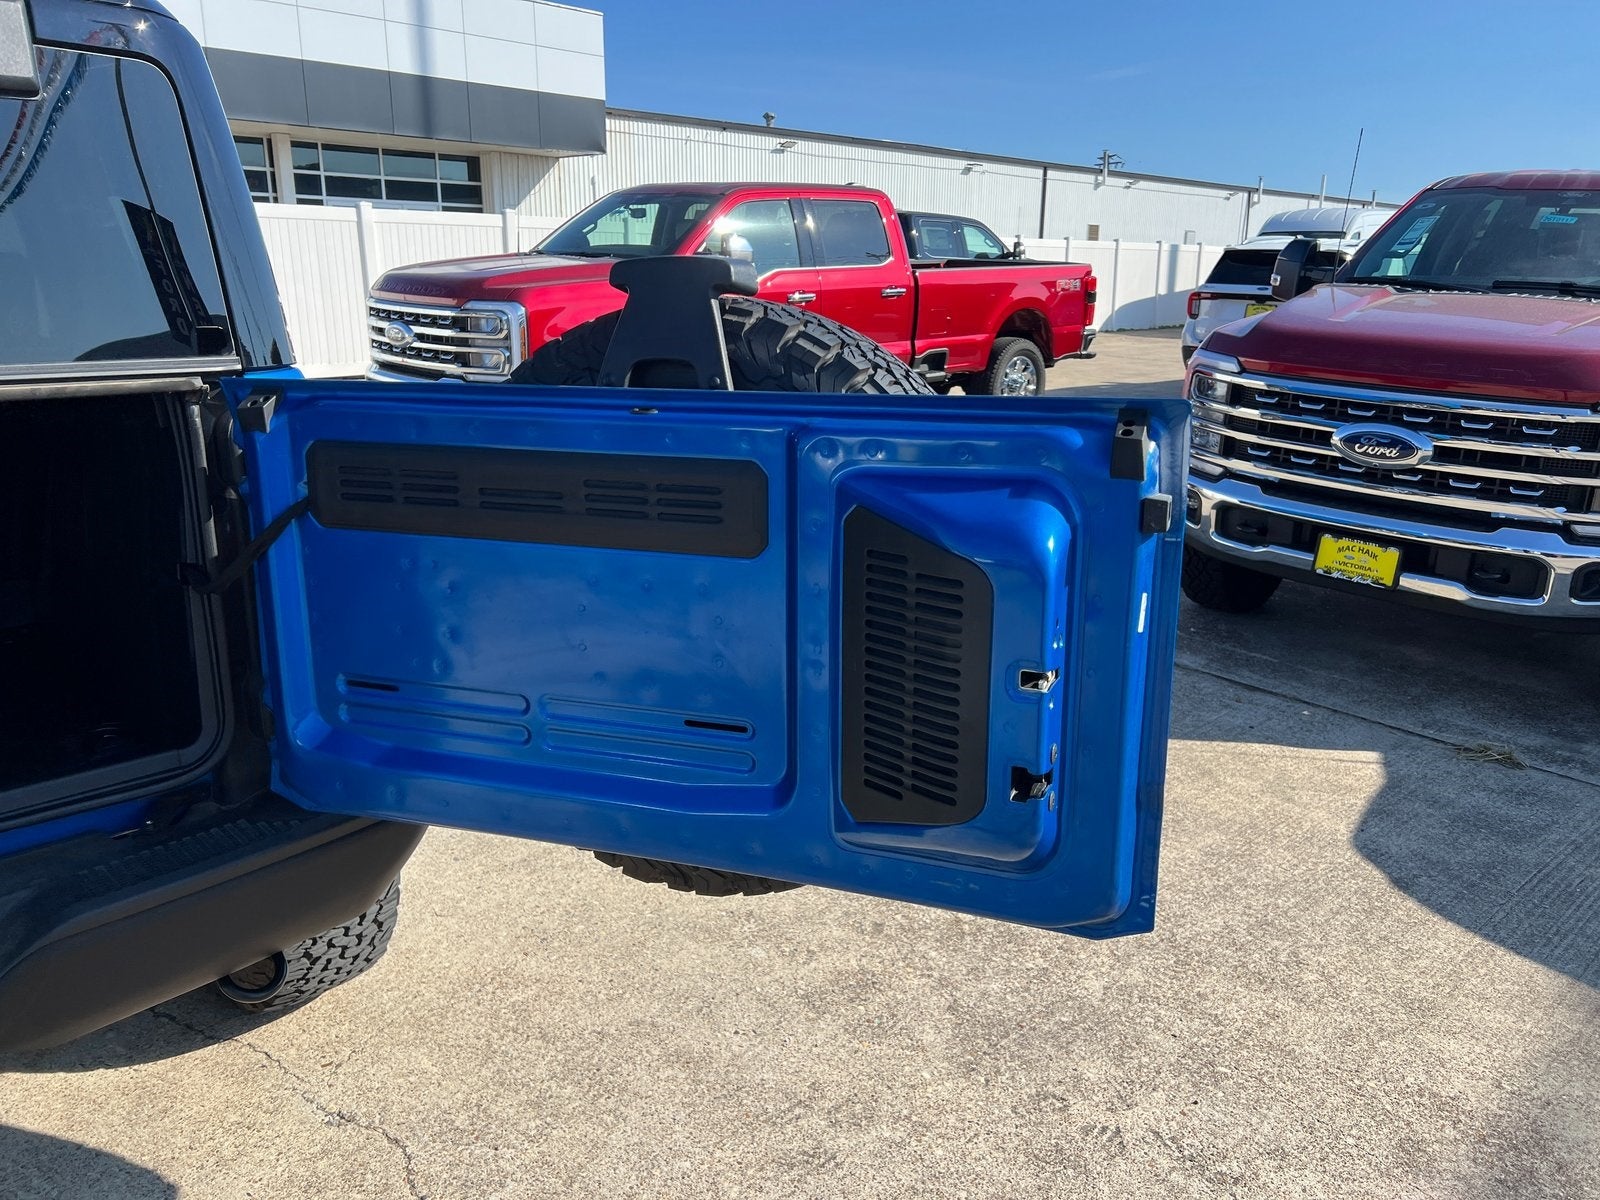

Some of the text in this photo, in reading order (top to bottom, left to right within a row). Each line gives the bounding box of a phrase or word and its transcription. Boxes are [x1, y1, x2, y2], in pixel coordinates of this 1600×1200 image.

[1056, 279, 1081, 292] FX4
[1354, 435, 1402, 458] Ford
[1337, 545, 1356, 554] MAC
[1358, 546, 1379, 562] HAIK
[1338, 560, 1372, 573] VICTORIA
